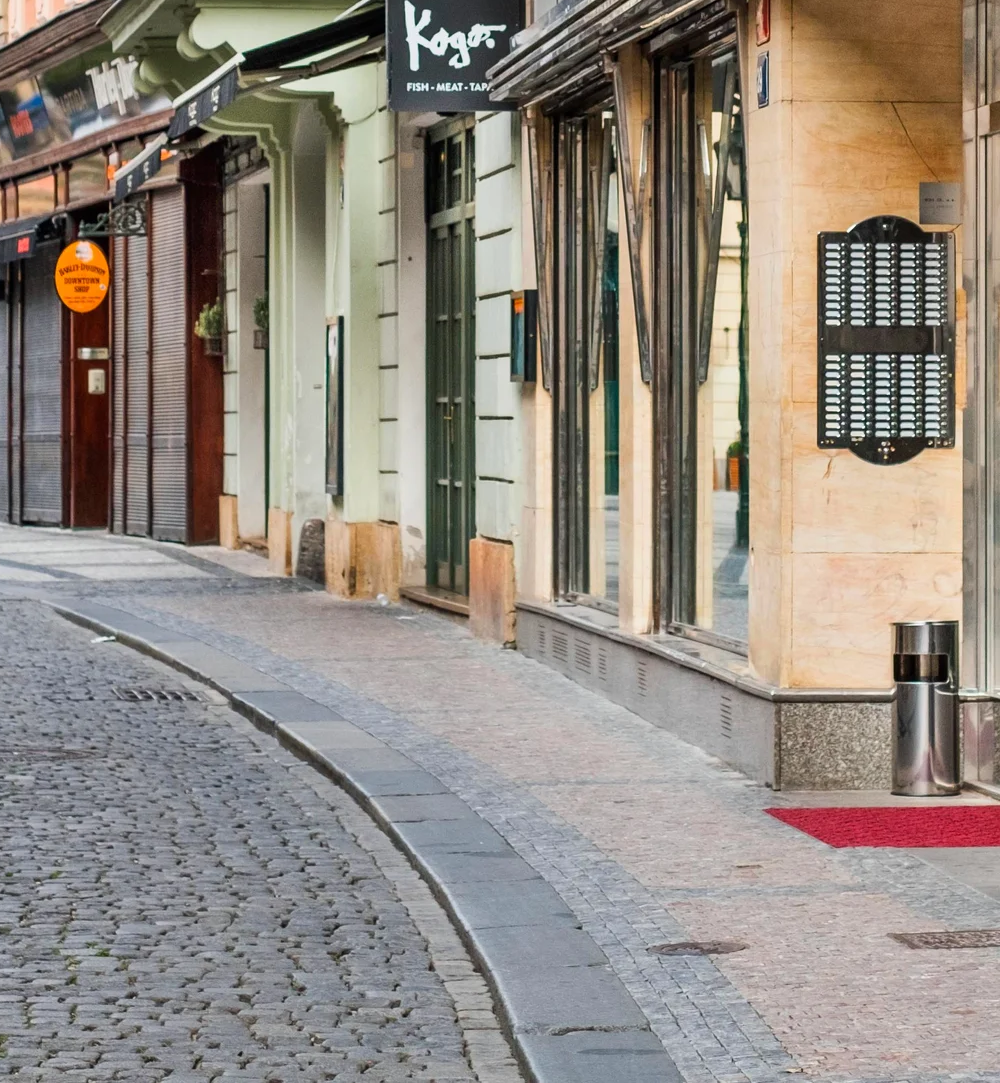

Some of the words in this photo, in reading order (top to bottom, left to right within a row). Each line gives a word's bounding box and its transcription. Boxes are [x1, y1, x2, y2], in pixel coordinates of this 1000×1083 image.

[406, 82, 429, 92] FISH
[436, 82, 463, 92] MEAT
[469, 82, 495, 92] TAP
[63, 277, 100, 285] DOWNTOWN
[74, 285, 90, 293] SHOP
